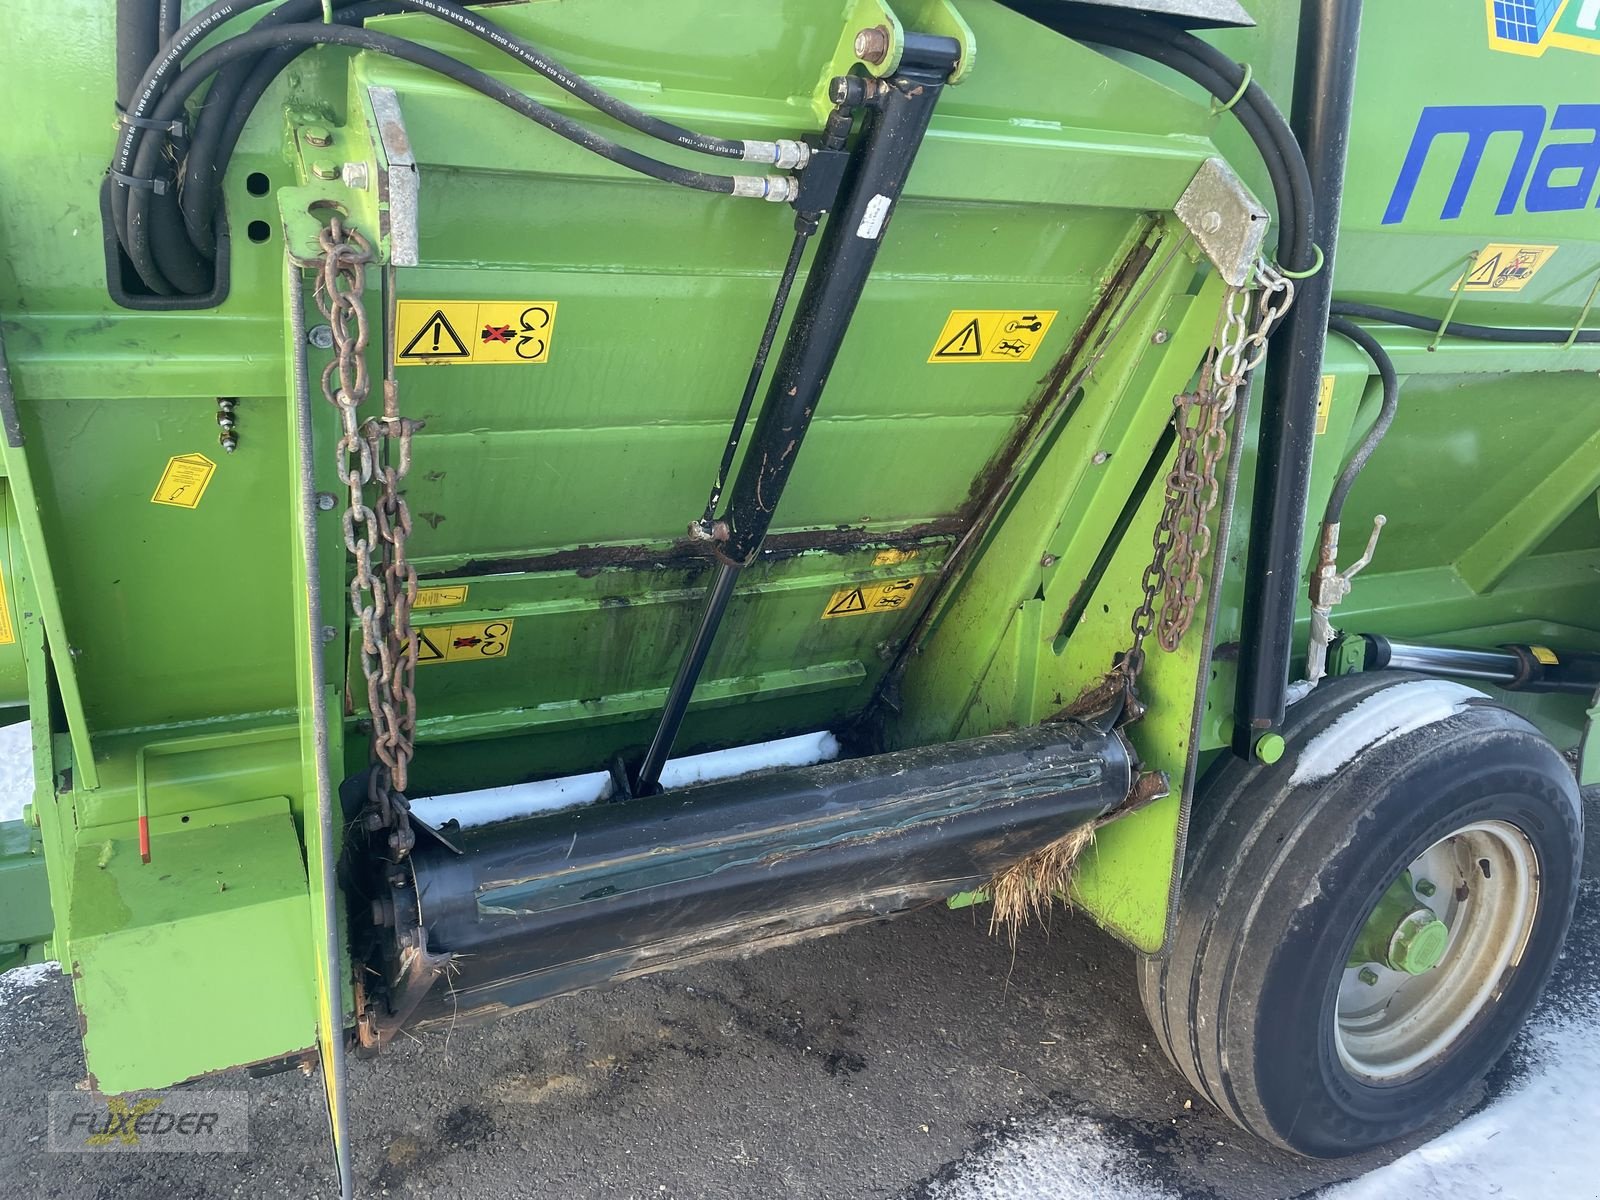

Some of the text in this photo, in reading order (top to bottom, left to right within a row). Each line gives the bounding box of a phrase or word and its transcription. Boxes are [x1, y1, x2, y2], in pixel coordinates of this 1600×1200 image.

[425, 1, 436, 9] 100
[437, 6, 450, 15] SAE
[211, 12, 221, 21] EN
[450, 11, 464, 22] BAR
[475, 24, 486, 34] WP
[181, 35, 191, 47] NW
[491, 32, 508, 46] 20022
[508, 43, 520, 52] DIN
[168, 49, 178, 61] DIN
[524, 53, 534, 62] NW
[156, 59, 170, 76] 20022
[557, 73, 566, 82] EN
[149, 79, 158, 90] WP
[137, 99, 147, 112] BAR
[678, 136, 693, 144] ITALY
[1381, 104, 1600, 225] ma
